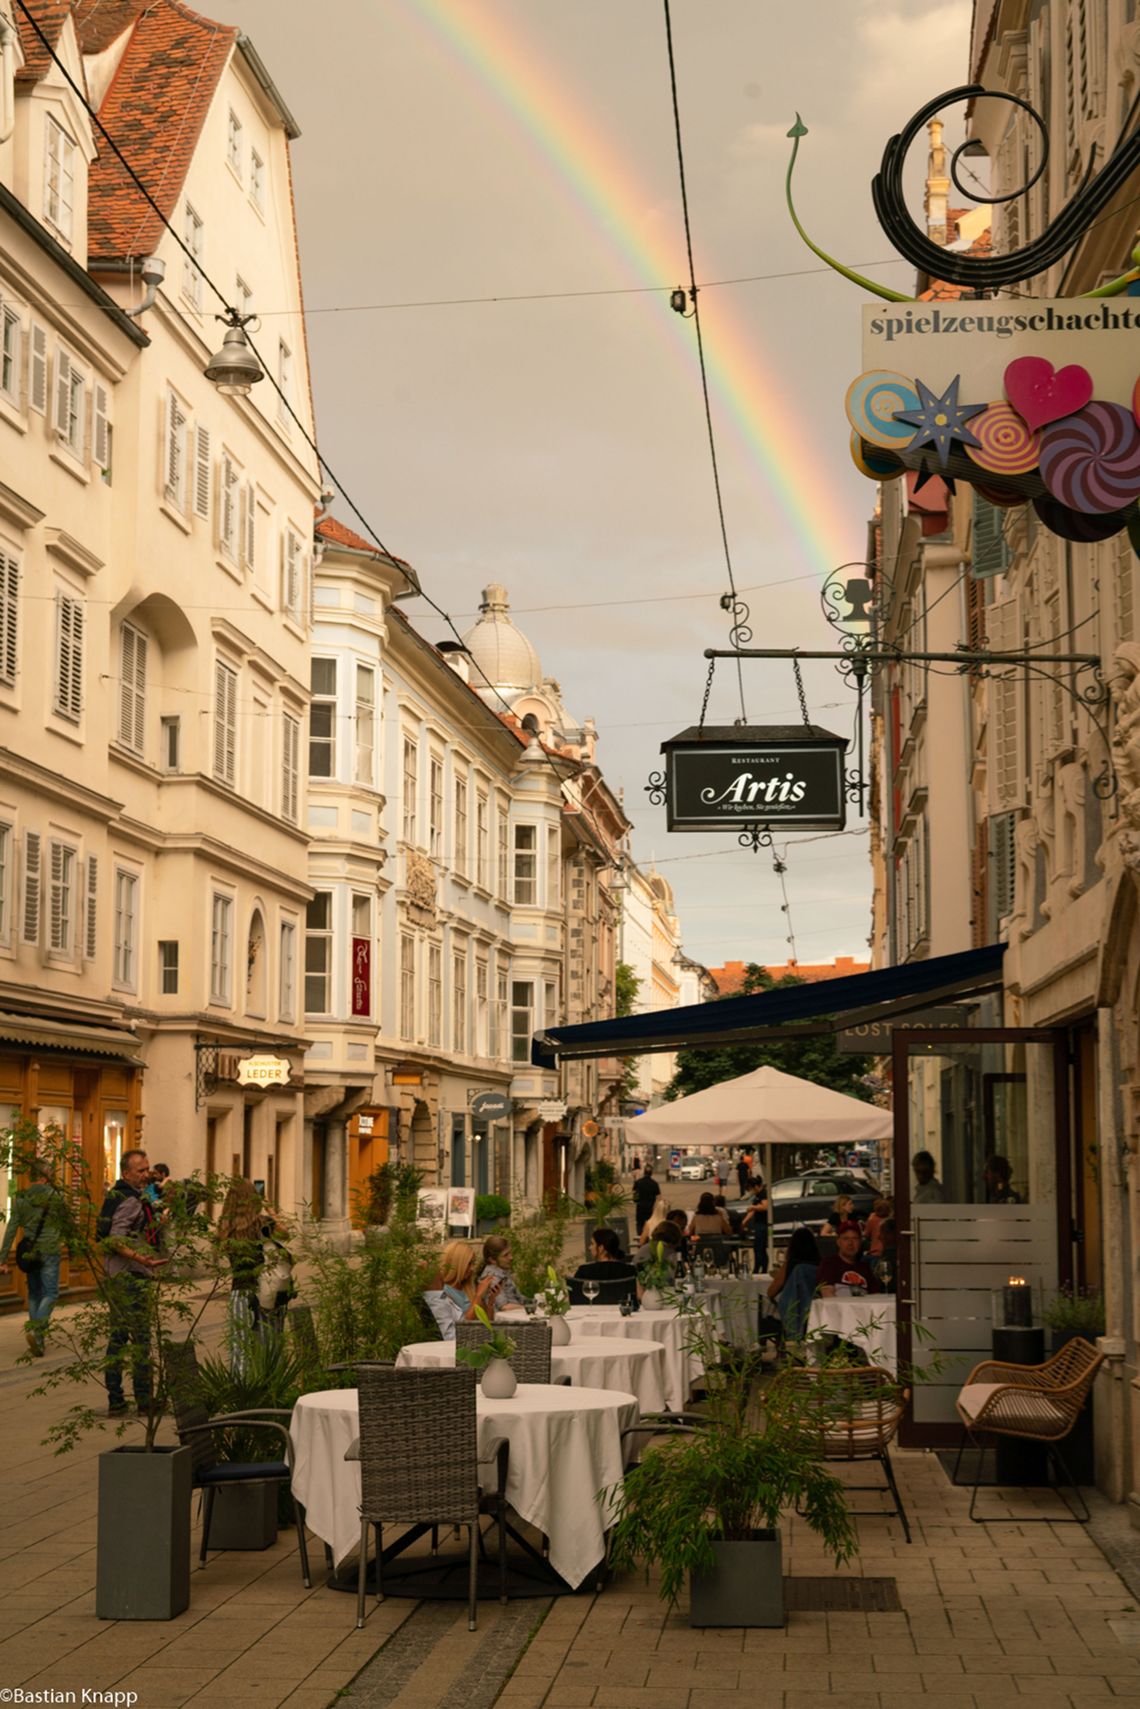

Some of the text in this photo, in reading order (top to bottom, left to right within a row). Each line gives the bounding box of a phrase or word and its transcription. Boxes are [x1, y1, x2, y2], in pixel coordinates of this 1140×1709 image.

[700, 772, 807, 804] Artis
[844, 1023, 893, 1037] LOST
[247, 1069, 282, 1079] LEDER
